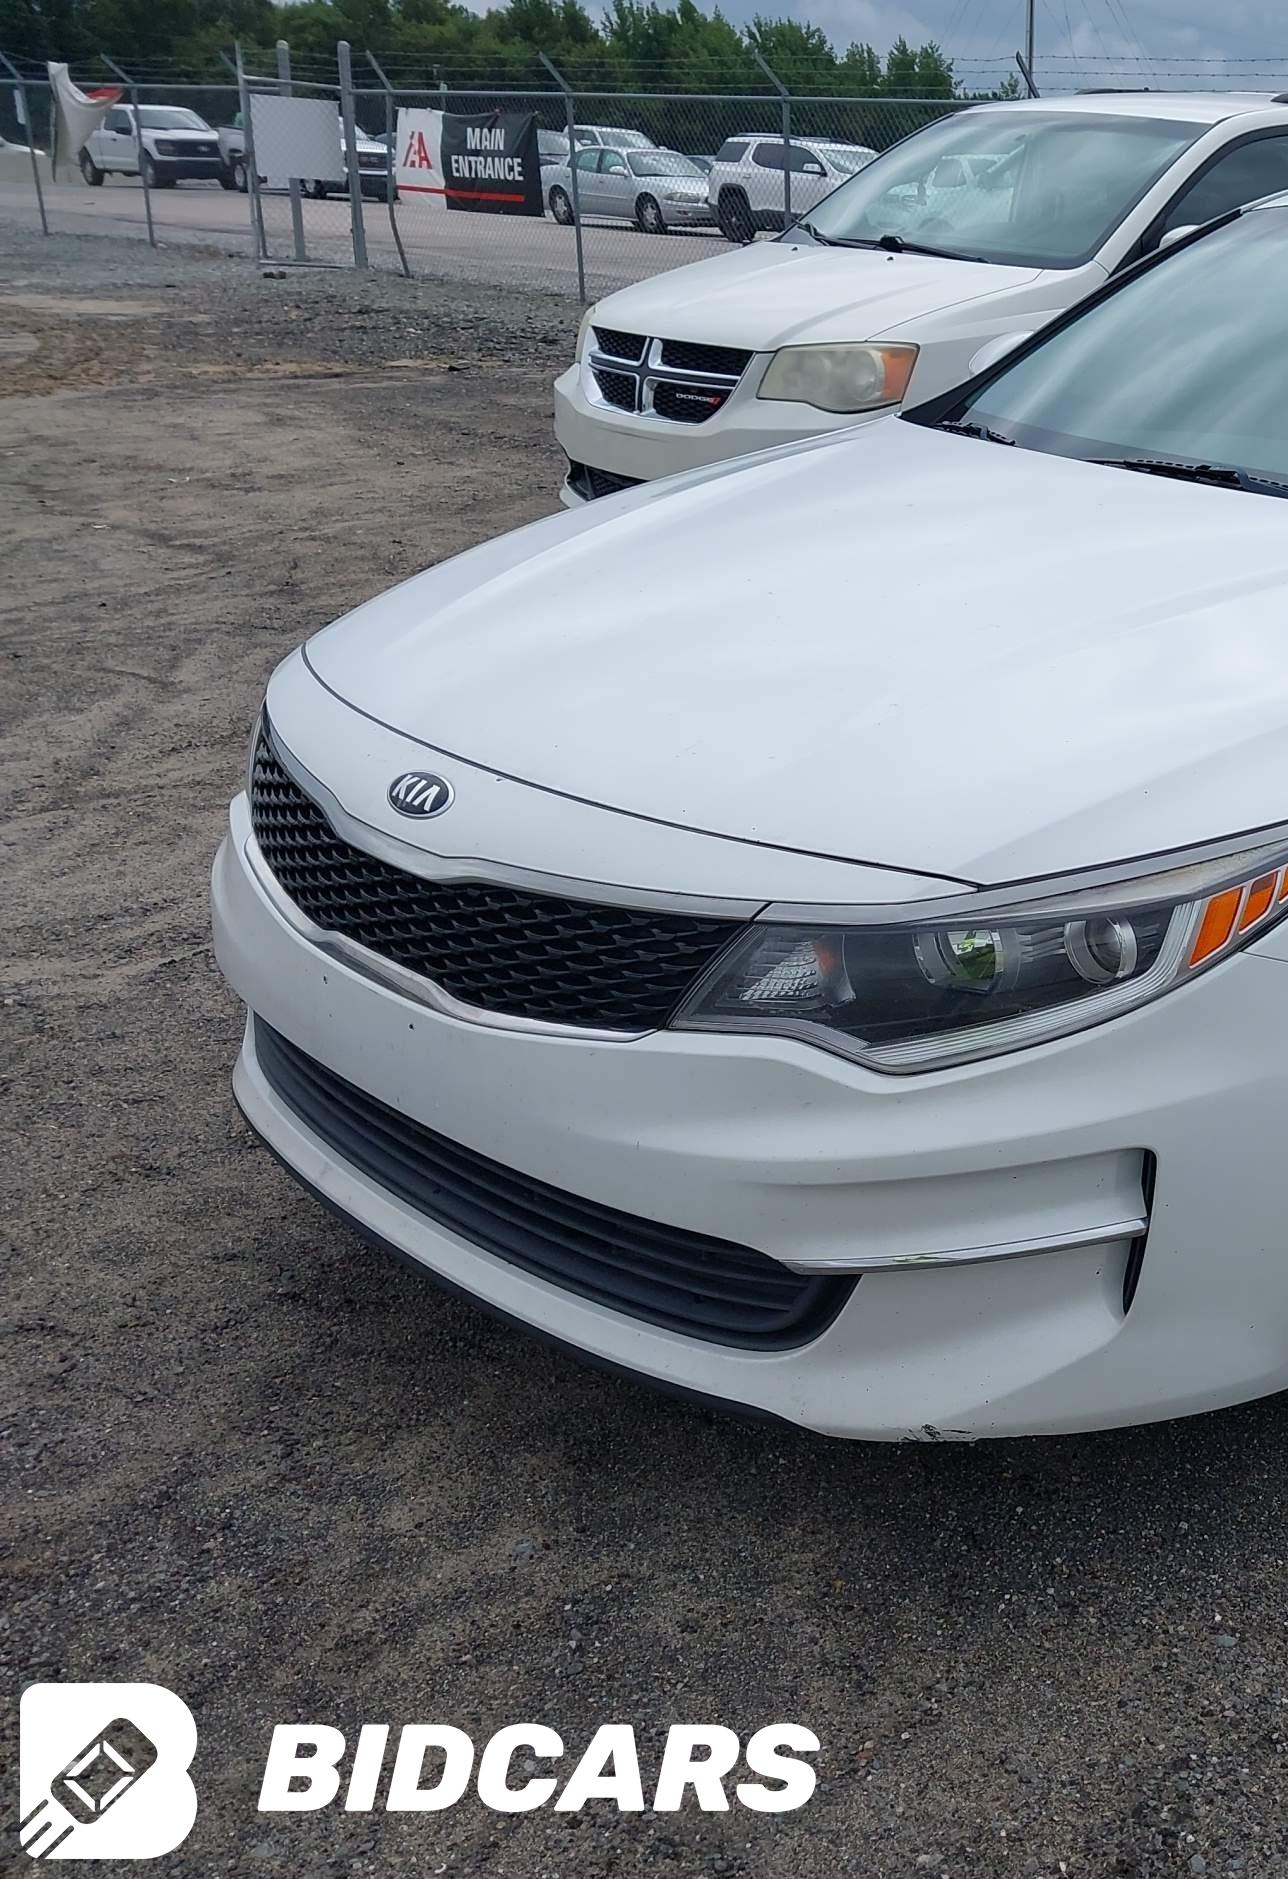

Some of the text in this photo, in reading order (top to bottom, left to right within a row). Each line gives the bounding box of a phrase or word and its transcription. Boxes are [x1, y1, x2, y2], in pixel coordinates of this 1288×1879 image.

[466, 127, 505, 150] MAIN
[451, 155, 524, 181] ENTRANCE
[391, 774, 441, 812] KIA
